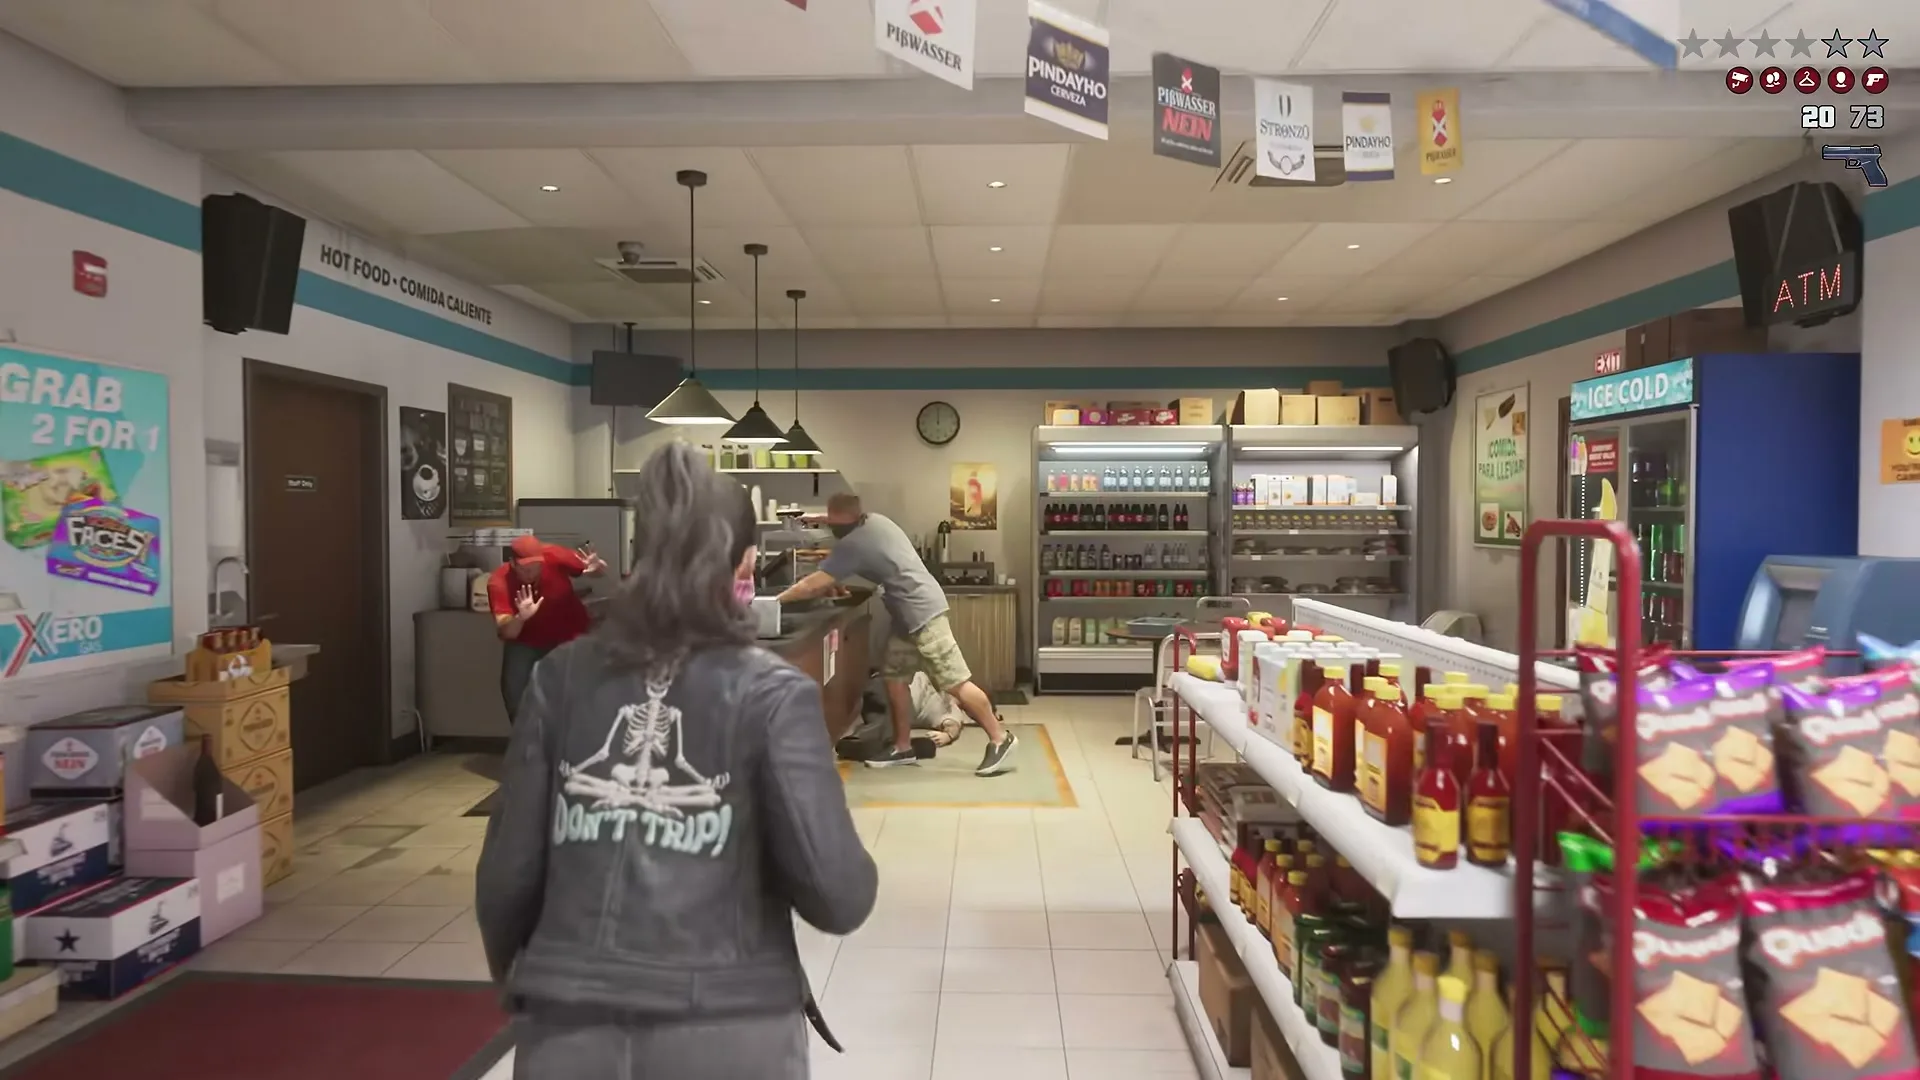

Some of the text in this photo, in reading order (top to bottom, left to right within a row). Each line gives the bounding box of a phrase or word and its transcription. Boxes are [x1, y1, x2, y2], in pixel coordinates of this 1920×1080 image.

[1028, 55, 1107, 100] PINDAYHO
[1050, 84, 1087, 107] CERVEZA
[1162, 107, 1213, 142] NEIN
[1345, 135, 1391, 151] PINDAYHO
[320, 244, 493, 326] HOT FOOD COMIDA CALIENTE
[1773, 263, 1843, 313] ATM
[1596, 352, 1621, 374] EXIT
[0, 362, 122, 413] GRAB
[1587, 373, 1669, 410] ICE COLD
[31, 413, 160, 452] 2 FOR 1
[66, 516, 146, 556] FACES
[552, 793, 733, 857] DON'T TRIP!
